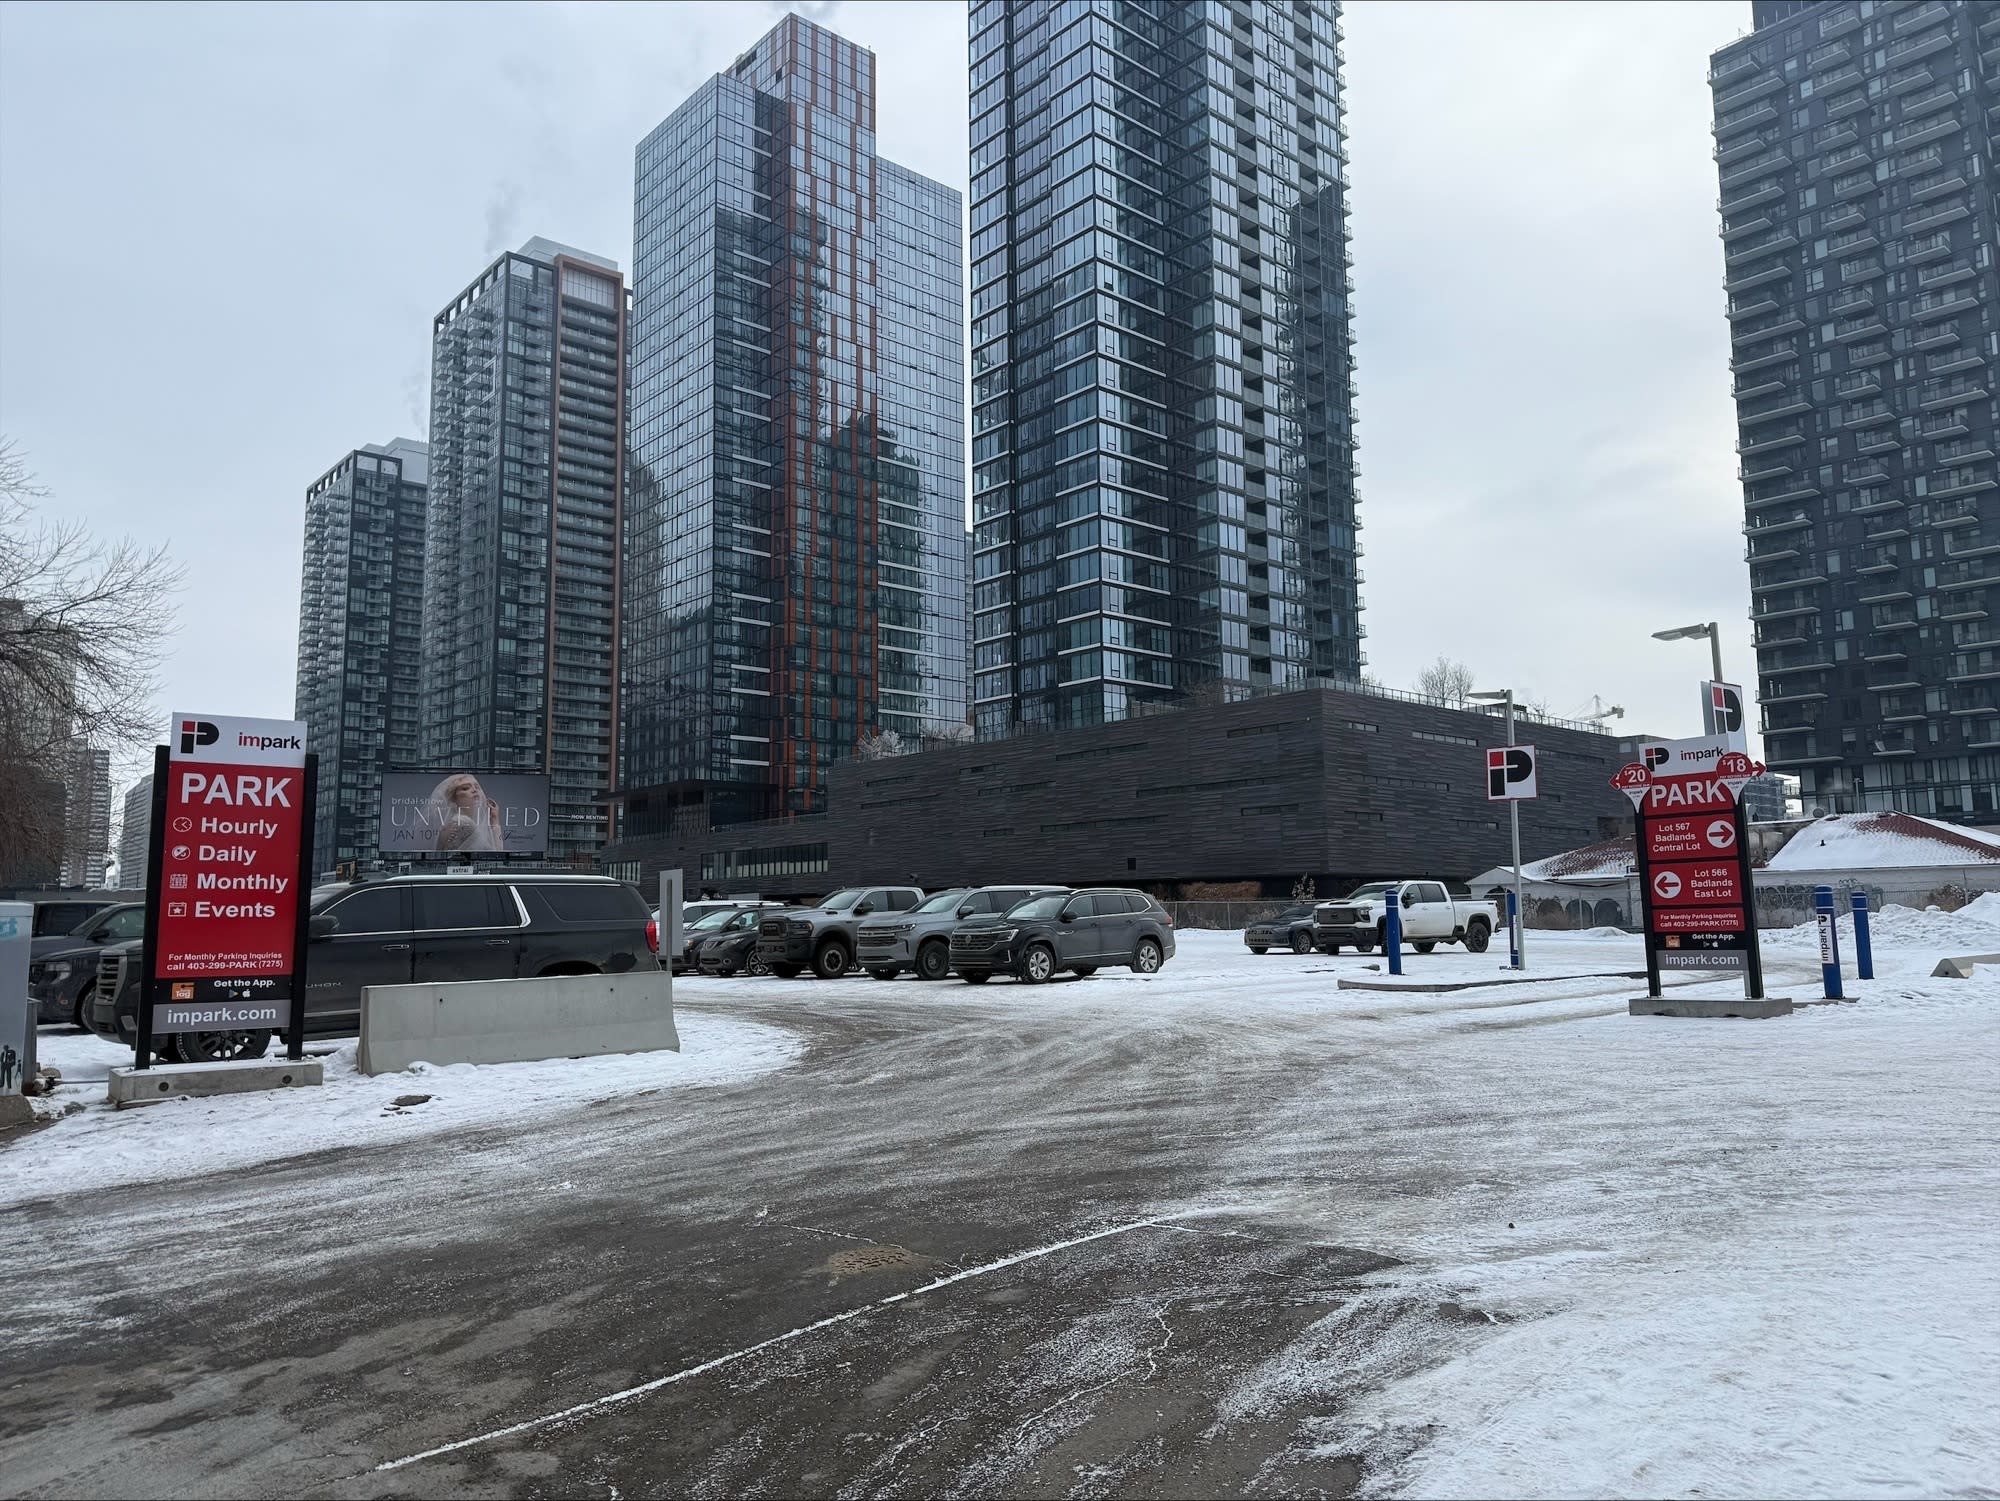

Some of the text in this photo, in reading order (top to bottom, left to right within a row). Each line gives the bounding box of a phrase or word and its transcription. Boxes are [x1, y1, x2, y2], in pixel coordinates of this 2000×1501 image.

[238, 732, 301, 751] impark
[1681, 747, 1723, 761] impark
[1722, 758, 1747, 773] $18
[1624, 769, 1646, 783] $20
[181, 772, 292, 808] PARK
[1651, 780, 1726, 808] PARK
[391, 796, 418, 805] bridal
[391, 806, 540, 827] UNVEILED
[201, 817, 278, 839] Hourly
[1659, 822, 1690, 832] Lot 567
[393, 829, 415, 842] JAN
[1655, 833, 1696, 842] Badlands
[1652, 843, 1701, 852] Central Lot
[199, 845, 257, 866] Daily
[1694, 869, 1728, 877] Lot 566
[197, 873, 288, 894] Monthly
[1691, 879, 1733, 888] Badlands
[1694, 889, 1732, 898] East Lot
[195, 901, 276, 918] Events
[1819, 928, 1830, 961] impark
[168, 952, 283, 962] For Monthly Parking Inquiries
[1665, 954, 1740, 967] impark.com
[166, 960, 284, 971] call 403-299-PARK (7275)
[213, 979, 276, 989] Get the App.
[167, 1008, 277, 1026] impark.com
